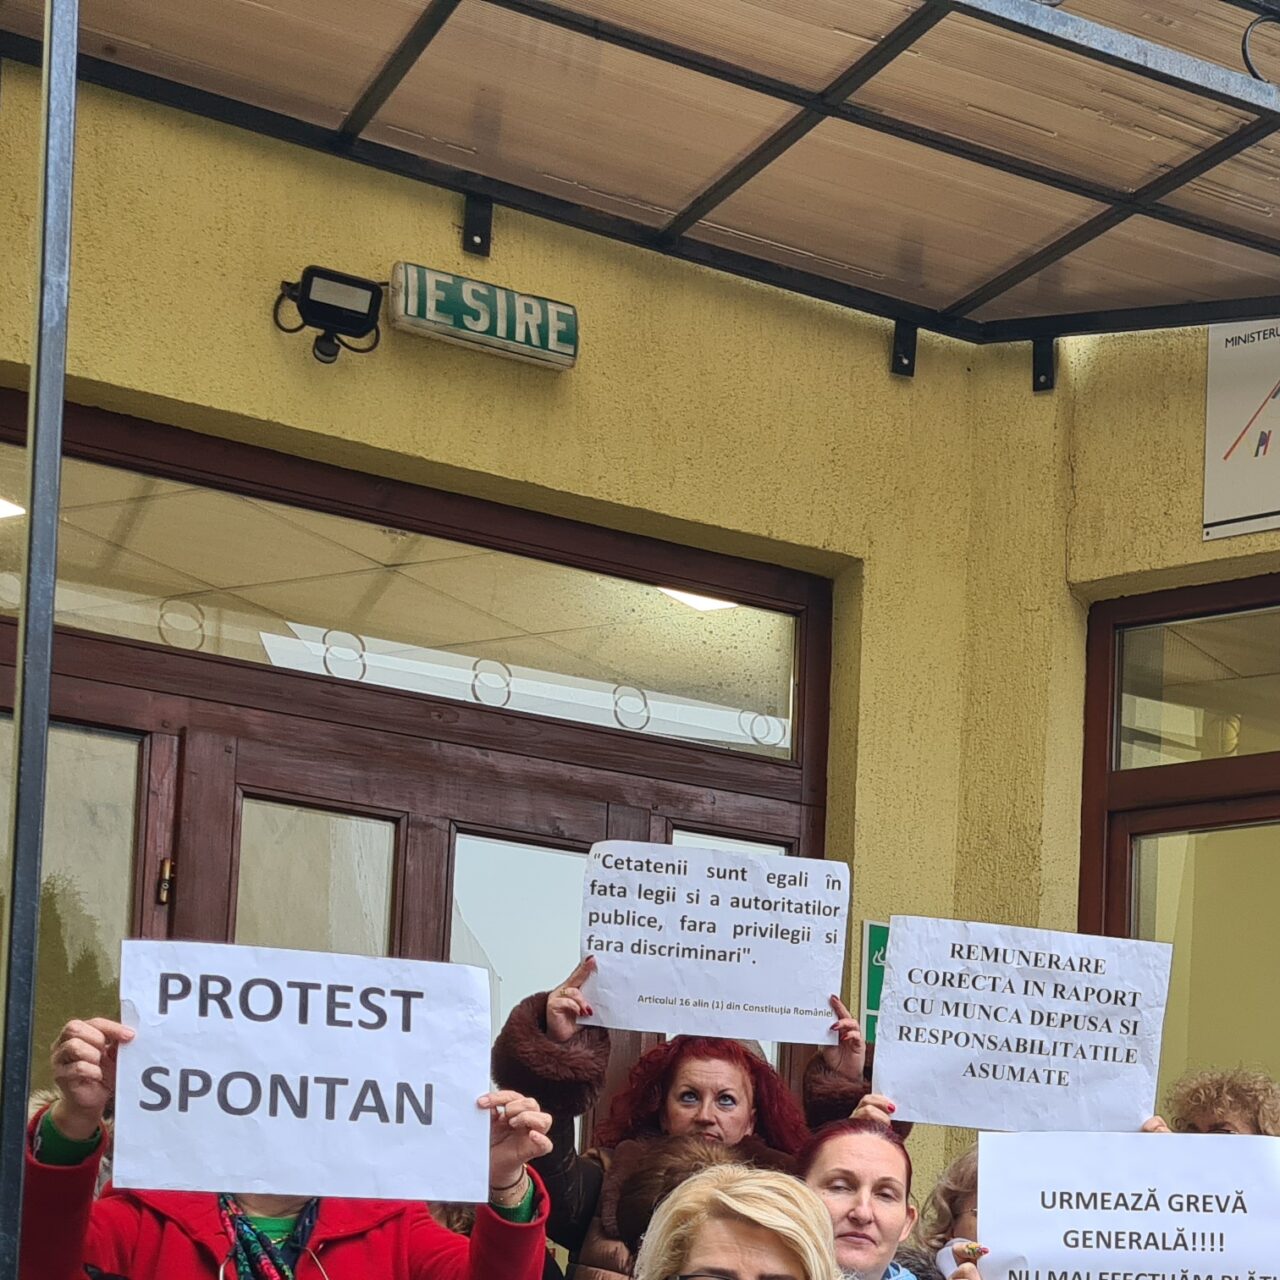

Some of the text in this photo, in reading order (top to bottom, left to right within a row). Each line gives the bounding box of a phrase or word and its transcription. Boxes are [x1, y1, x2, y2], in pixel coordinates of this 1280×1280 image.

[406, 265, 575, 354] IESIRE
[707, 866, 748, 882] sunt
[766, 870, 808, 888] egali
[826, 874, 841, 891] în
[590, 880, 840, 917] fata legii si a autoritatilor
[588, 909, 838, 944] publice, fara privilegii si
[587, 936, 624, 953] fara
[951, 943, 1106, 975] REMUNERARE
[158, 972, 424, 1032] PROTEST
[638, 995, 677, 1005] Articolul
[679, 998, 690, 1006] 16
[692, 999, 709, 1009] alin
[711, 1000, 724, 1011] (1)
[726, 1001, 741, 1010] din
[907, 968, 1141, 1008] CORECTA IN RAPORT
[903, 997, 1138, 1036] CU MUNCA DEPUSA SI
[898, 1026, 1138, 1064] RESPONSABILITATILE
[962, 1062, 1070, 1087] ASUMATE
[139, 1066, 434, 1126] SPONTAN
[1041, 1188, 1247, 1214] URMEAZĂ GREVĂ
[1063, 1227, 1224, 1252] GENERALĂ!!!!
